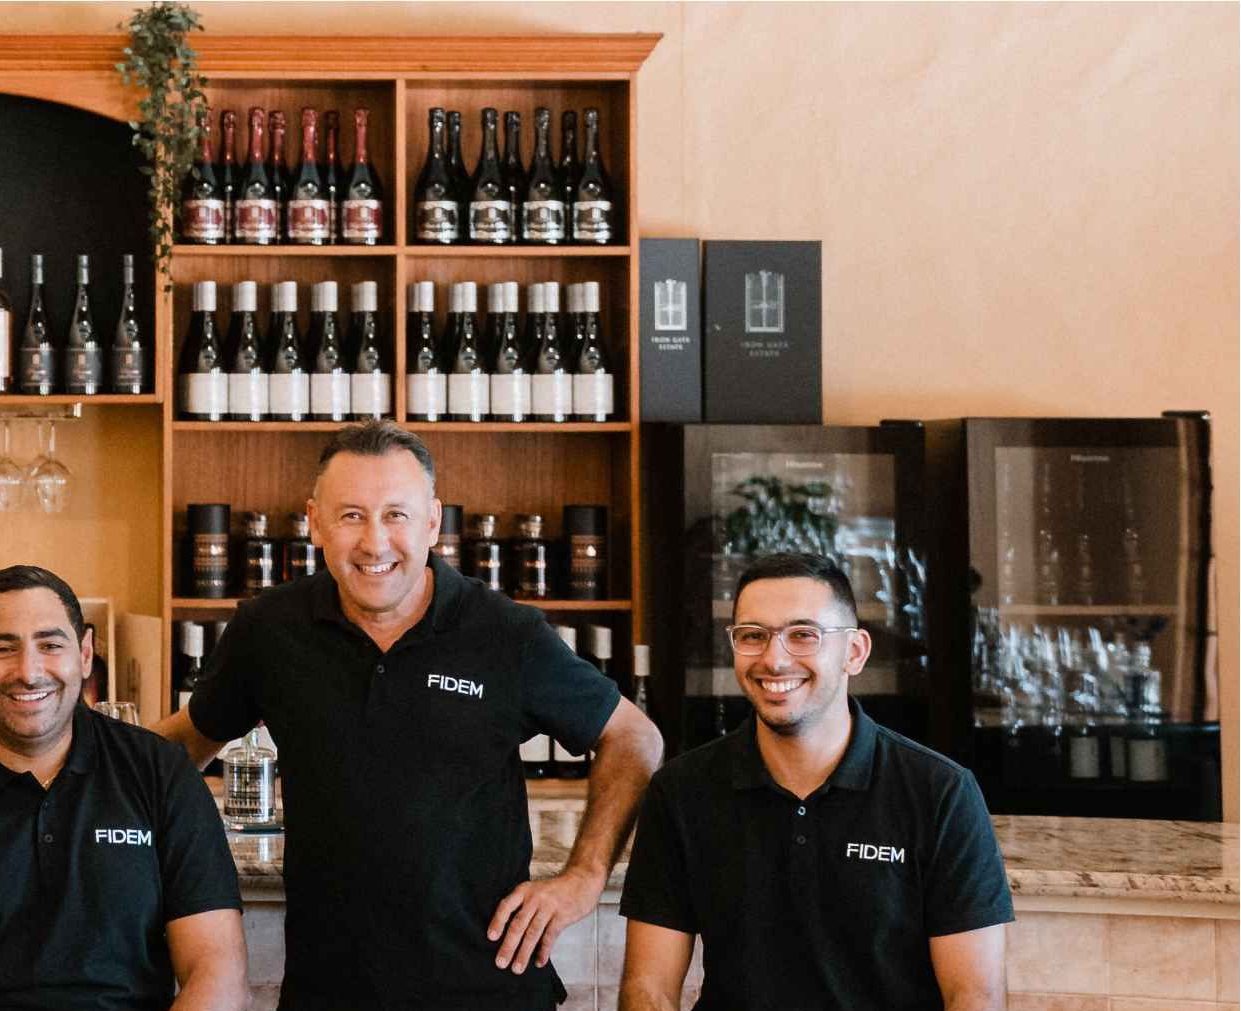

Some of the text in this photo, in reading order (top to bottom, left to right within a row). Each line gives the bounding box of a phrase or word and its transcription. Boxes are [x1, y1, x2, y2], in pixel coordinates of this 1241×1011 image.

[427, 673, 484, 699] FIDEM
[94, 828, 152, 847] FIDEM
[846, 842, 905, 864] FIDEM
